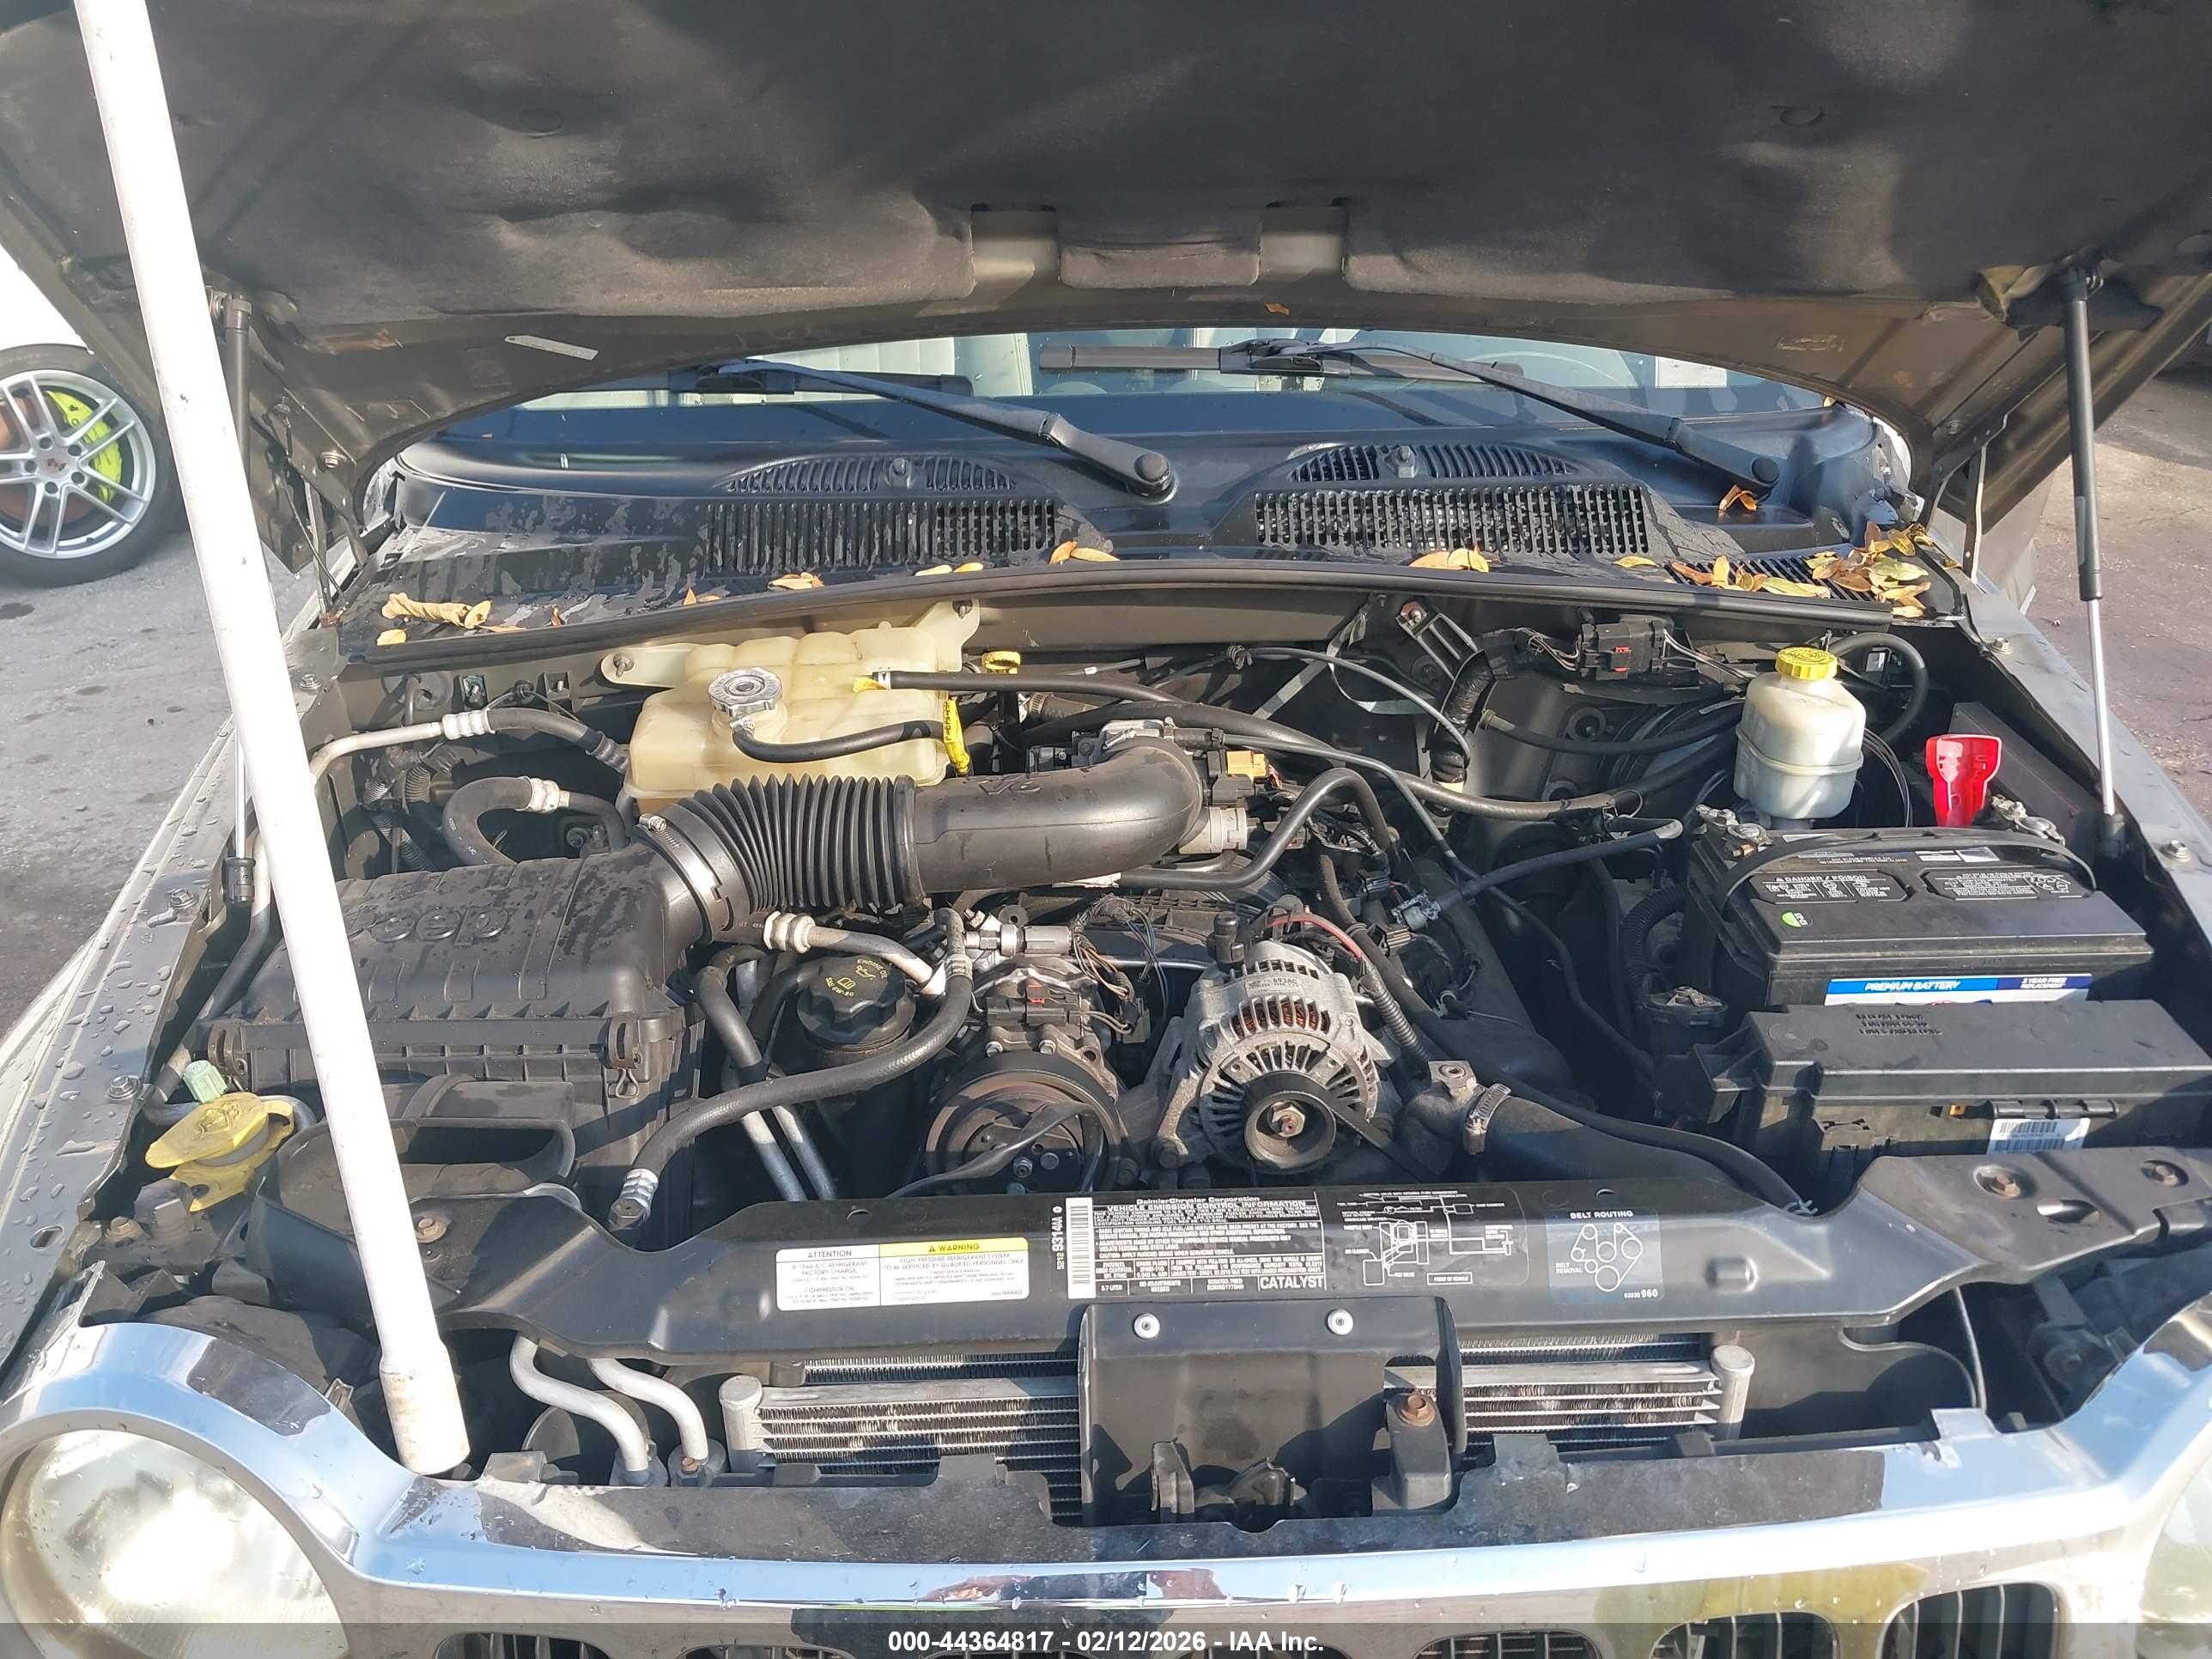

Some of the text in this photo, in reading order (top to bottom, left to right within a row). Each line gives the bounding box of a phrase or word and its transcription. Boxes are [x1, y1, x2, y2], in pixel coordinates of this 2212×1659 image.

[1864, 980, 1961, 991] PREMIUM BATTERY
[1148, 1202, 1194, 1211] EMISSION
[1242, 1200, 1306, 1208] INFORMATION
[1594, 1210, 1634, 1218] ROUTING
[939, 1243, 980, 1252] WARNING
[807, 1249, 852, 1258] ATTENTION
[1260, 1275, 1323, 1290] CATALYST
